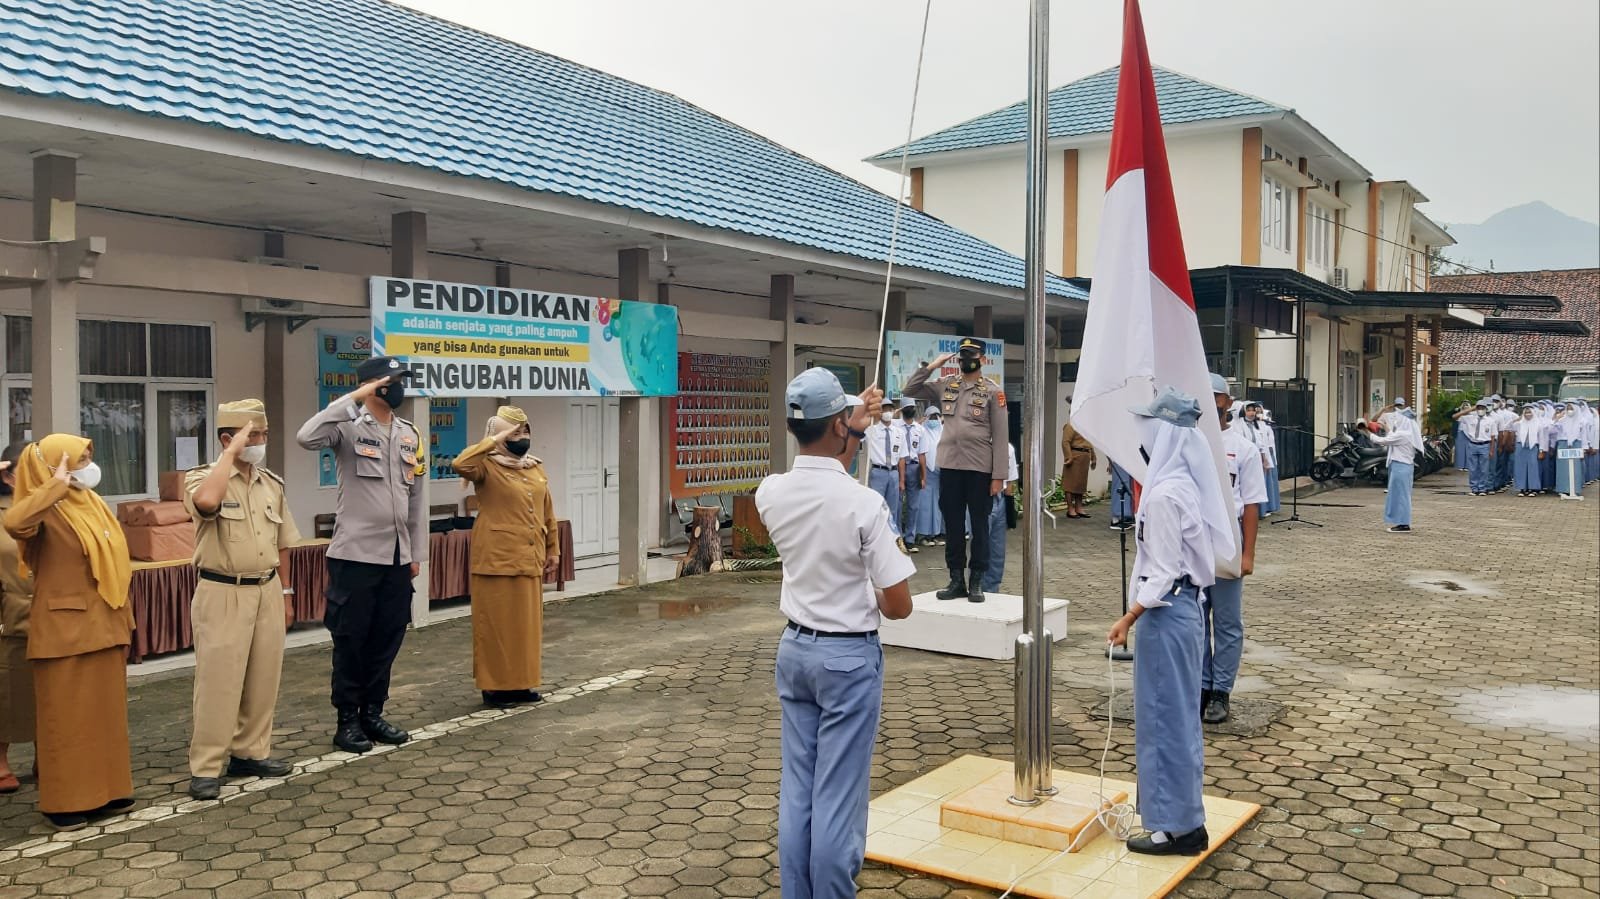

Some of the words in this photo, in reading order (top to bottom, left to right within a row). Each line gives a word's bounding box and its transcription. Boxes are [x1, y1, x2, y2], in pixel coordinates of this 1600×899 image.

[386, 280, 590, 321] PENDIDIKAN
[402, 316, 442, 331] adalah
[445, 320, 486, 335] senjata
[488, 324, 513, 337] yang
[515, 325, 545, 340] paling
[547, 328, 578, 340] ampuh
[413, 340, 441, 354] yang
[443, 341, 467, 353] bisa
[469, 342, 497, 354] Anda
[499, 345, 542, 357] gunakan
[543, 346, 570, 357] untuk
[529, 366, 590, 391] DUNIA
